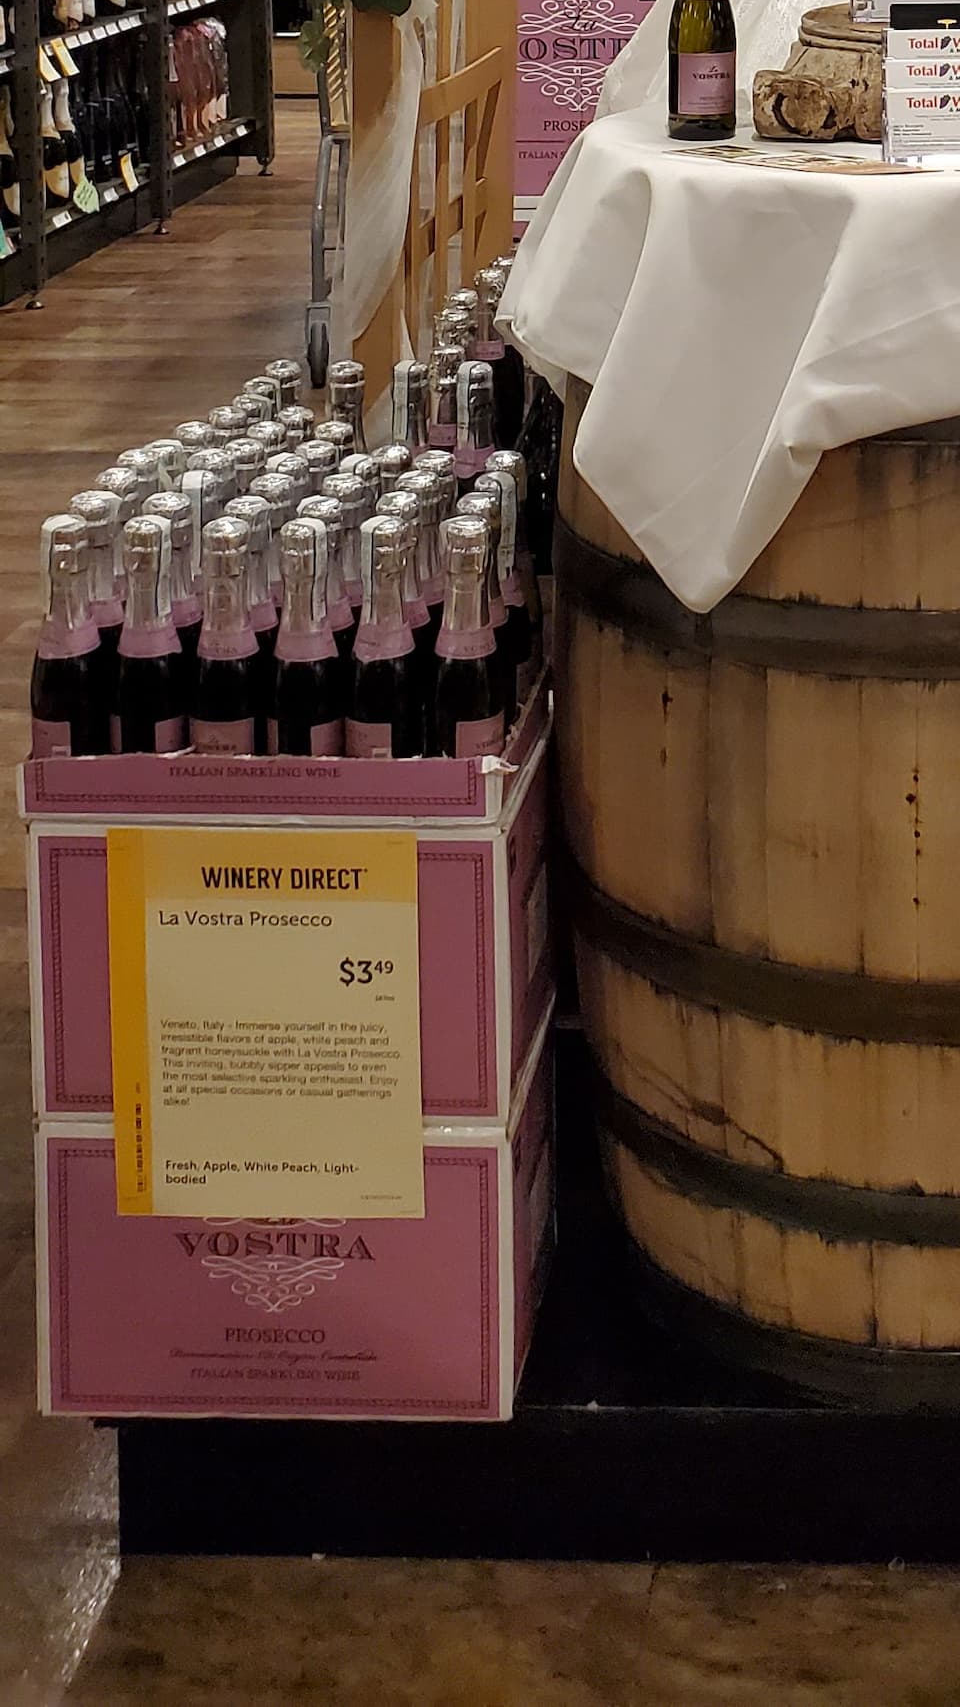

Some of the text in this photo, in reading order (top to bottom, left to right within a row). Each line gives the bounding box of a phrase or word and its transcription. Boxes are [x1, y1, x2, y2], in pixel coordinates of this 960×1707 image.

[563, 7, 599, 31] La
[519, 37, 630, 60] OST
[908, 38, 938, 49] Total
[907, 64, 937, 76] Total
[907, 96, 937, 108] Total
[543, 120, 589, 131] PROSE
[518, 151, 558, 159] ITALIAN
[169, 765, 341, 778] ITALIAN SPARKLING WINE
[201, 866, 363, 890] WINERY DIRECT
[159, 910, 333, 927] La Vostra Prosecco
[202, 1021, 225, 1031] Italy
[235, 1021, 281, 1030] Immerse
[284, 1022, 325, 1032] yourself
[328, 1023, 338, 1031] in
[340, 1022, 357, 1031] the
[217, 1034, 251, 1043] flavors
[254, 1034, 264, 1043] of
[302, 1035, 331, 1044] white
[334, 1036, 366, 1046] peach
[369, 1037, 389, 1045] and
[161, 1046, 347, 1058] fragrant honeysuckle with La Vostra
[165, 1160, 359, 1175] Fresh, Apple, White Peach, Light-
[165, 1174, 206, 1184] bodied
[174, 1232, 376, 1260] VOSTRA
[224, 1328, 326, 1343] PROSECCO
